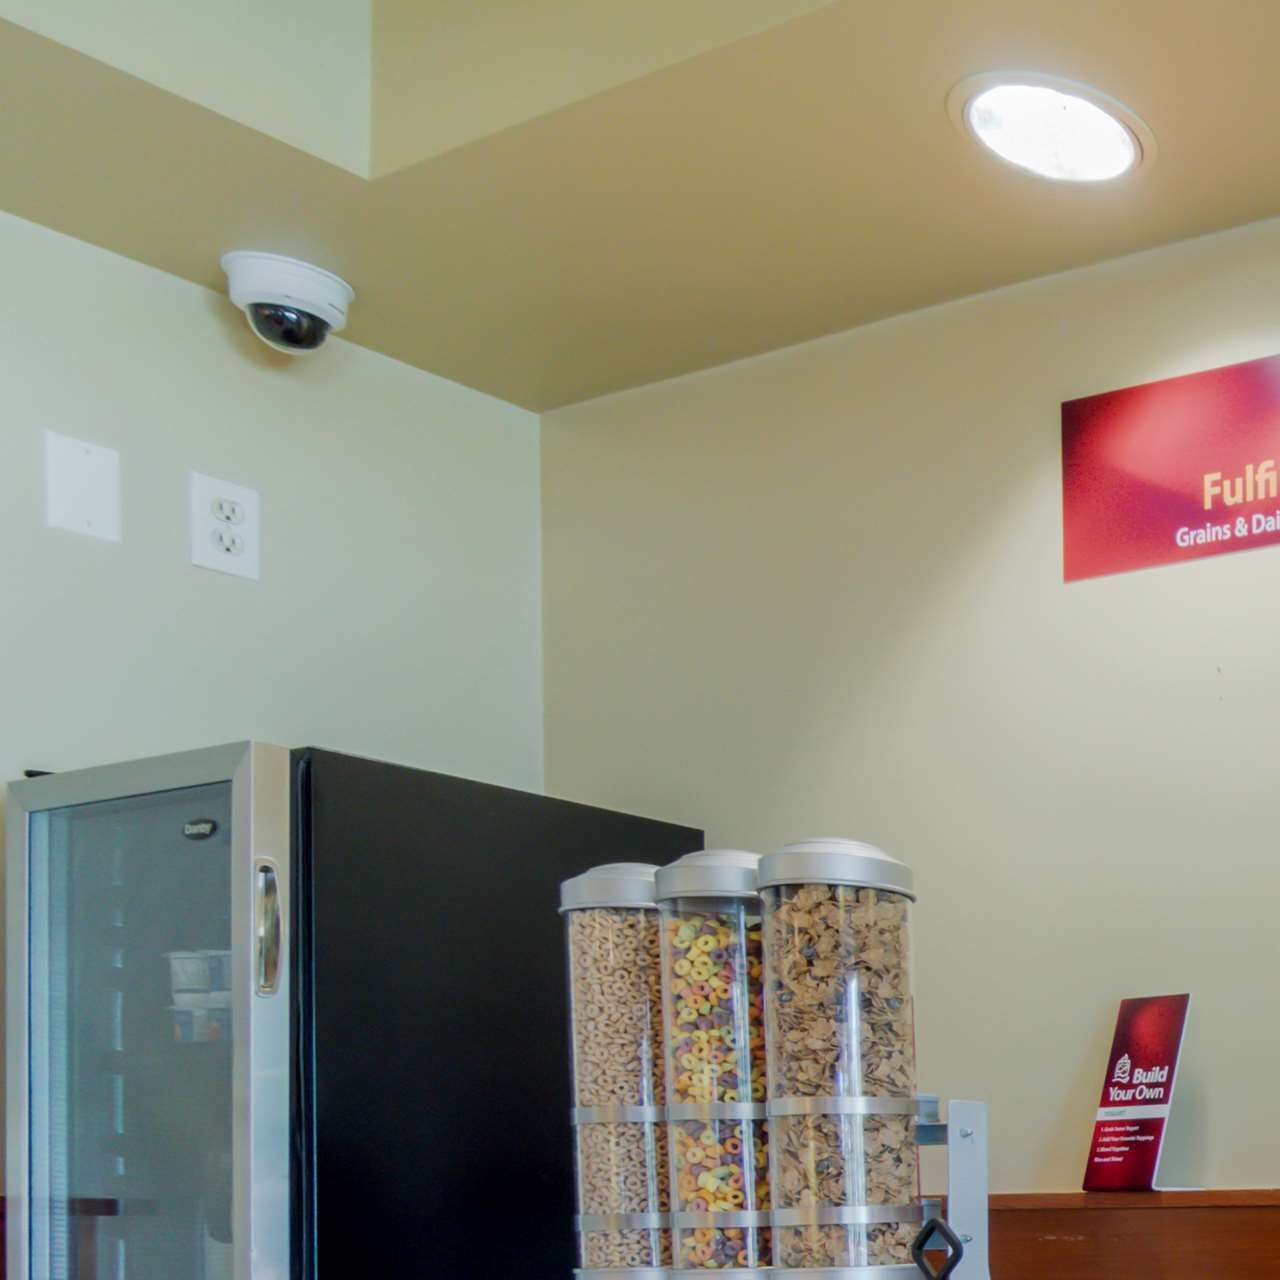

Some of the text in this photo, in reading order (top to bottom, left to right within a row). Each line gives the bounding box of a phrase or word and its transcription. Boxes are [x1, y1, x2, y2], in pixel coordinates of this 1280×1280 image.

[1175, 523, 1231, 548] Grains
[1234, 516, 1248, 537] &
[1132, 1066, 1169, 1084] Build
[1108, 1085, 1164, 1101] Your Own
